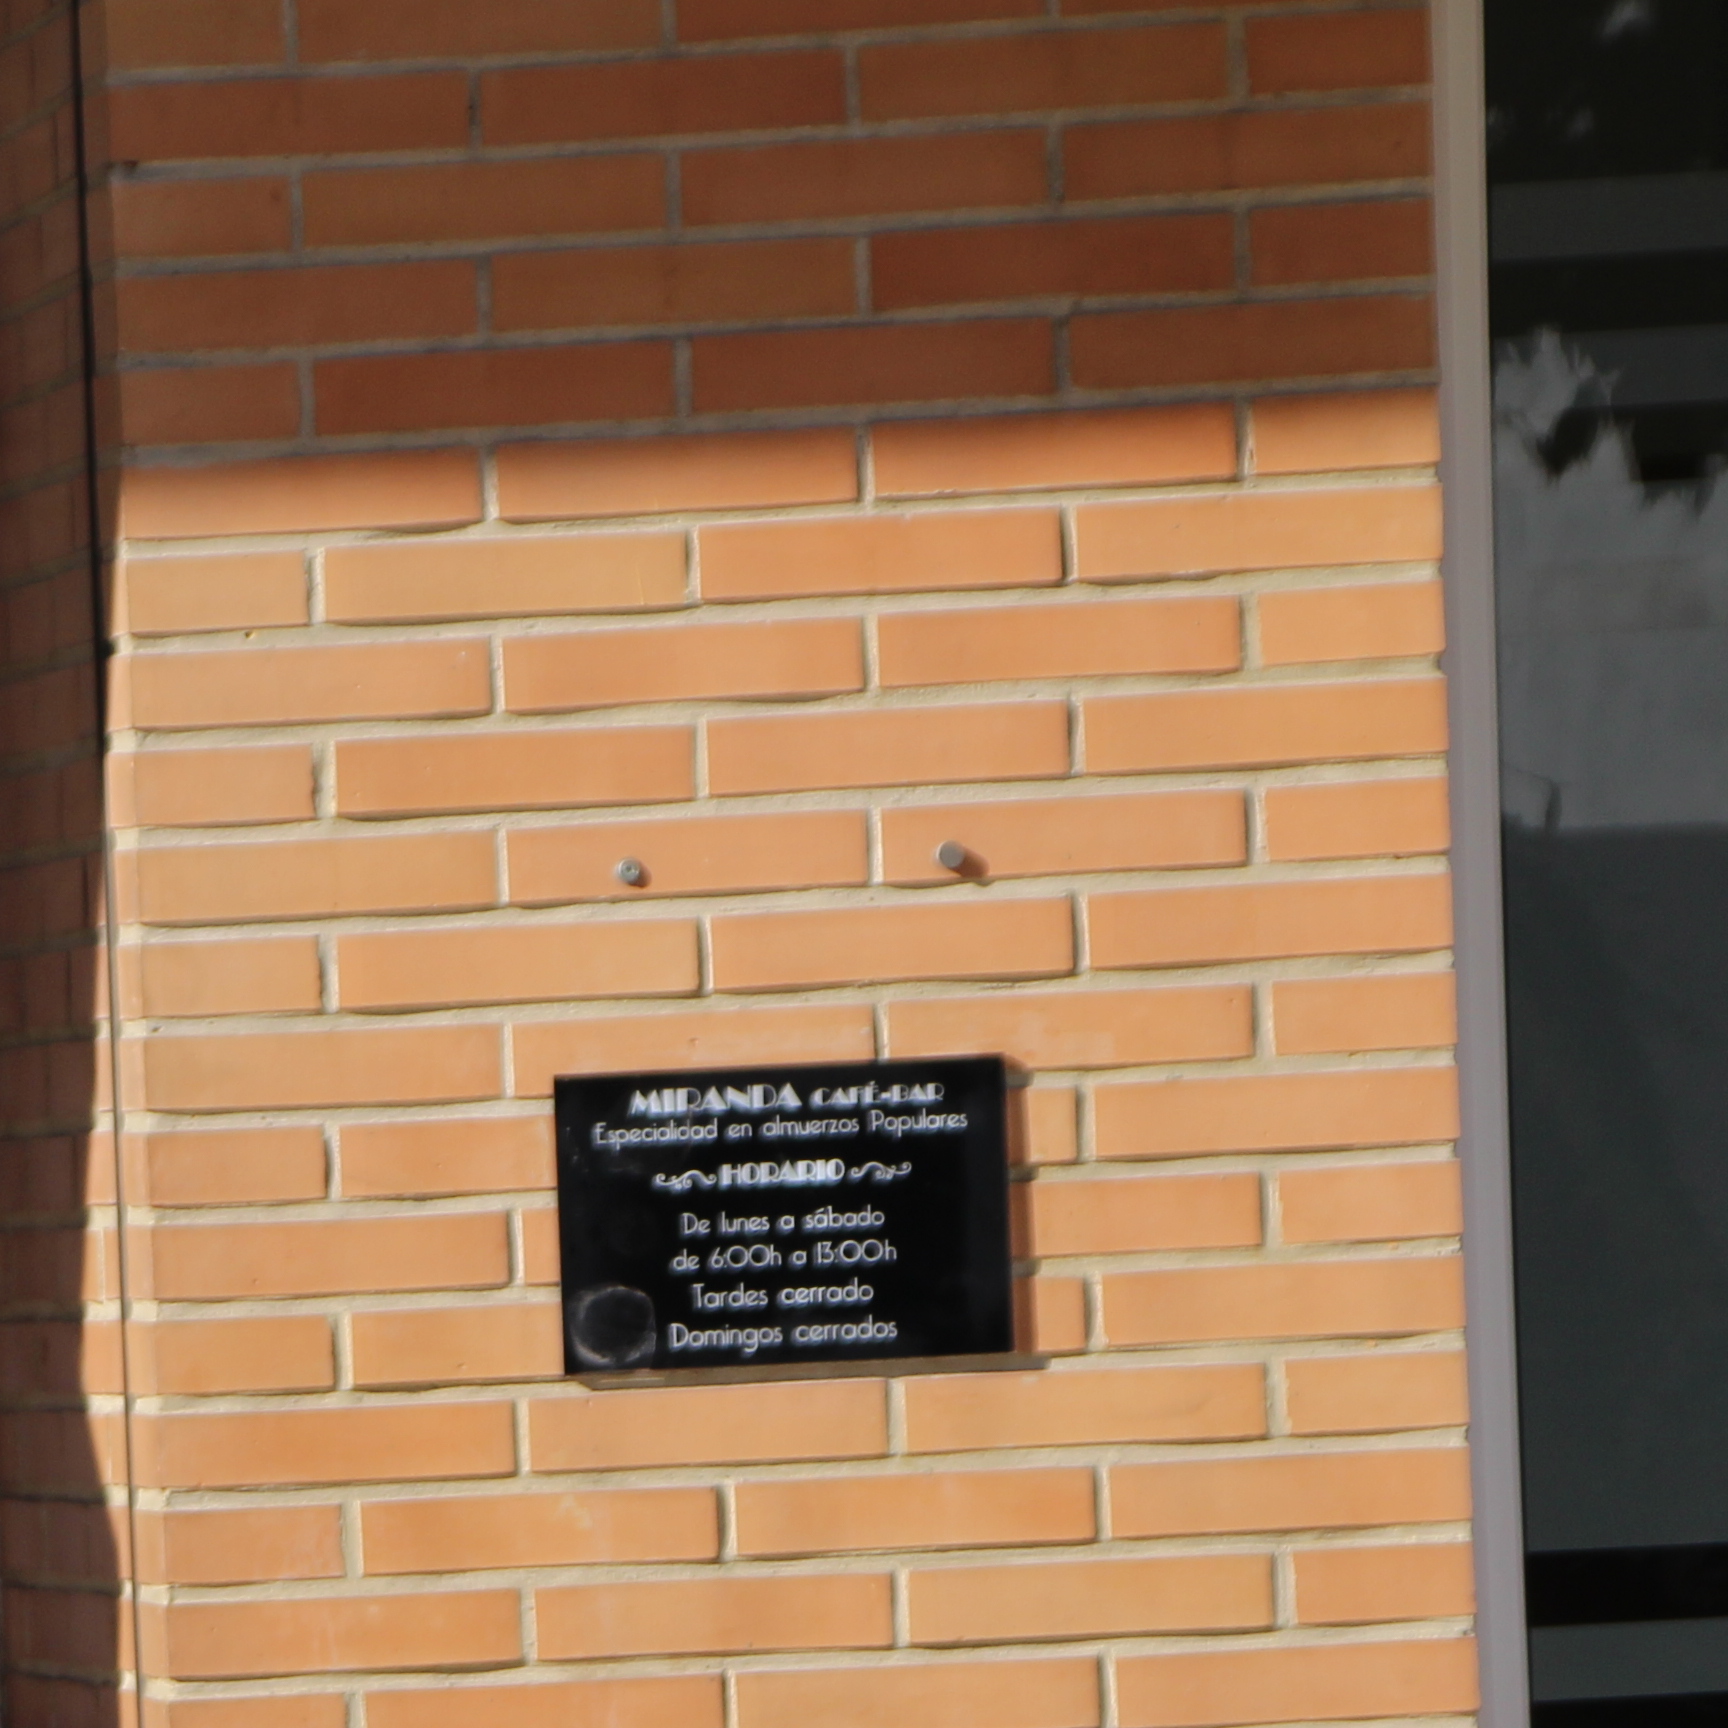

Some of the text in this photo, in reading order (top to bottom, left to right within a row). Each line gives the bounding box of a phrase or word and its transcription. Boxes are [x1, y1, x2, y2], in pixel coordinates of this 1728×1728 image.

[627, 1082, 802, 1115] MIRANDA
[592, 1108, 968, 1149] Especialidad en almuerzos Populares
[718, 1158, 846, 1189] HORARIO
[681, 1205, 885, 1235] De lunes a sábado
[671, 1239, 897, 1271] de 6:00h a 13:00h
[692, 1278, 874, 1310] Tardes cerrado
[668, 1316, 897, 1354] Domingos cerrados
